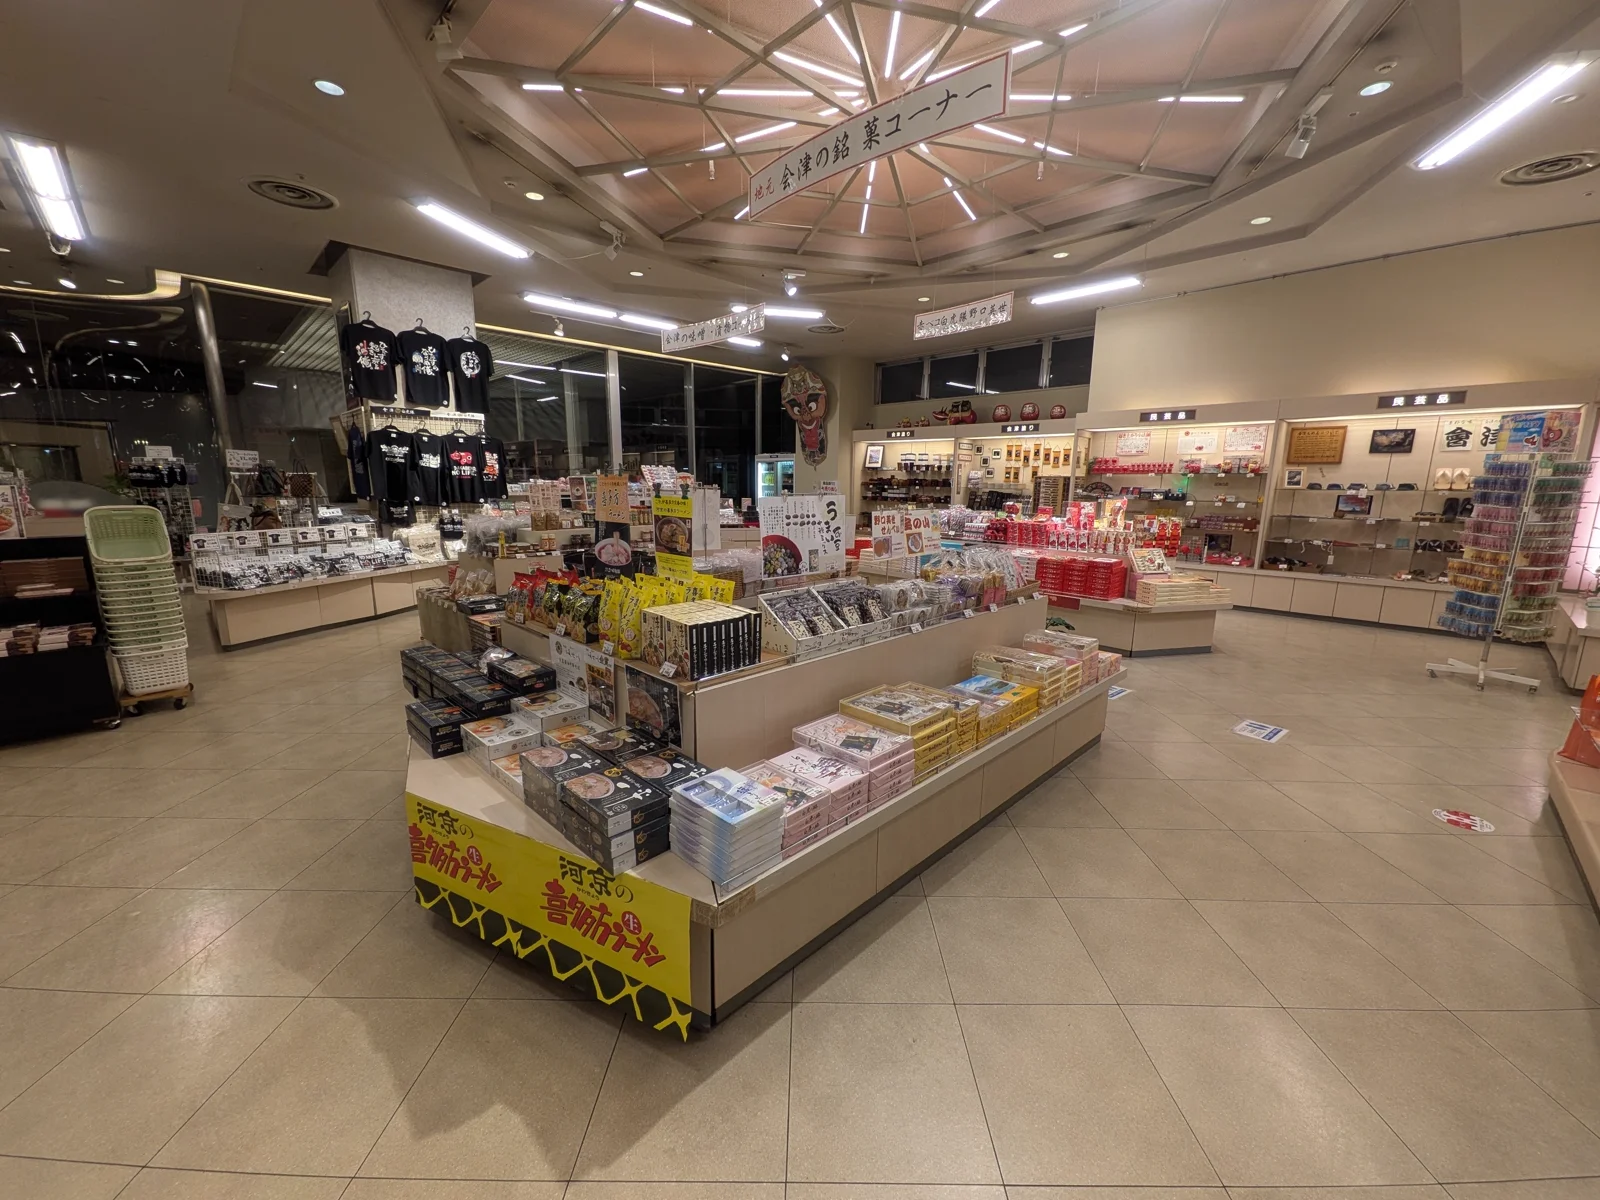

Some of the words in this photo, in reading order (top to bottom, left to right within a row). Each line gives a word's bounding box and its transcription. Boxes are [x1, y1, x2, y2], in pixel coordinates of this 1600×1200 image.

[753, 177, 775, 202] 地元
[779, 83, 992, 191] 会津の銘菓コーナー
[1392, 394, 1449, 407] 民芸品
[1149, 412, 1186, 421] 民芸品
[1006, 425, 1034, 433] 会津塗り
[416, 801, 475, 840] 河京の
[469, 846, 481, 864] 生
[558, 855, 634, 904] 河京の
[540, 878, 666, 968] 喜多方ラーメン
[623, 913, 640, 932] 生
